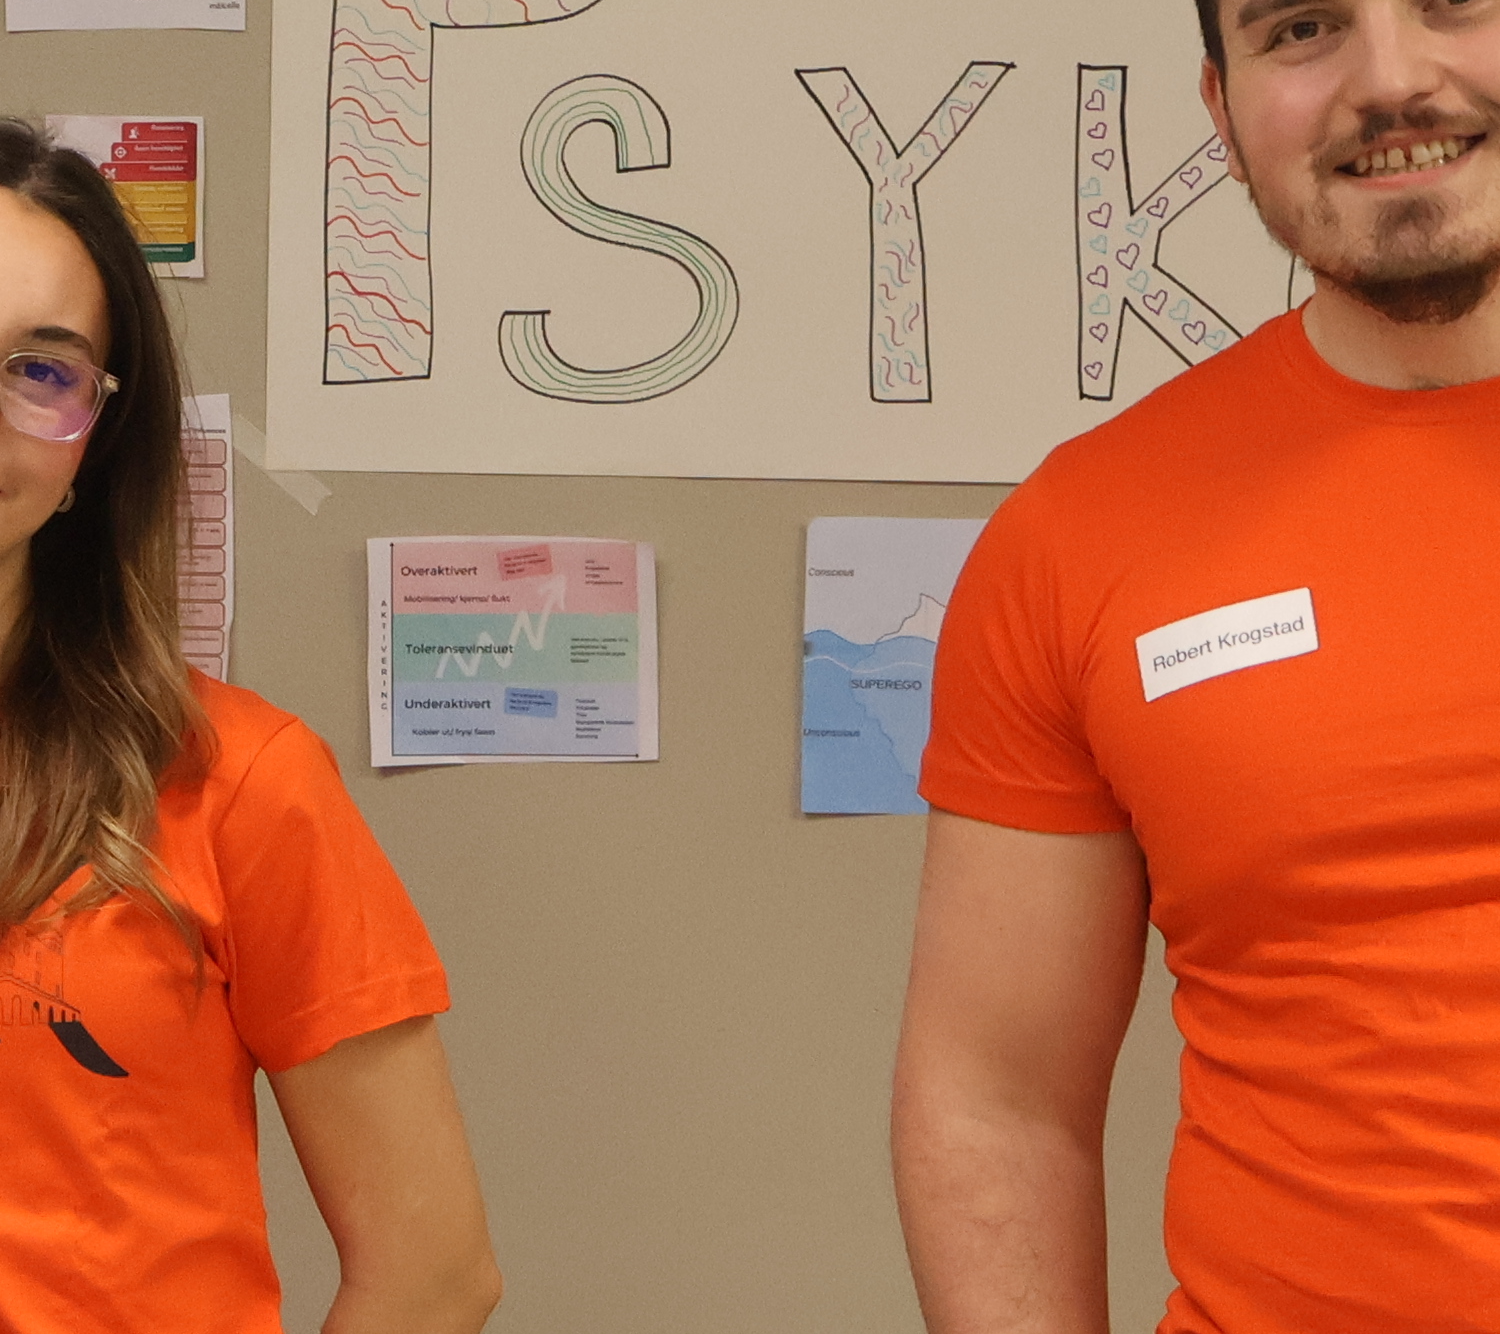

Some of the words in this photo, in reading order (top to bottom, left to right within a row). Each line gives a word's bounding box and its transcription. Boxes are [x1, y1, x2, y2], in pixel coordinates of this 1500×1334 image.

[400, 564, 479, 578] Overaktivert
[404, 642, 515, 656] Toleransevinduet
[1150, 637, 1215, 675] Robert
[1216, 614, 1306, 654] Krogstad
[850, 678, 923, 691] SUPEREGO
[404, 697, 492, 711] Underaktivert
